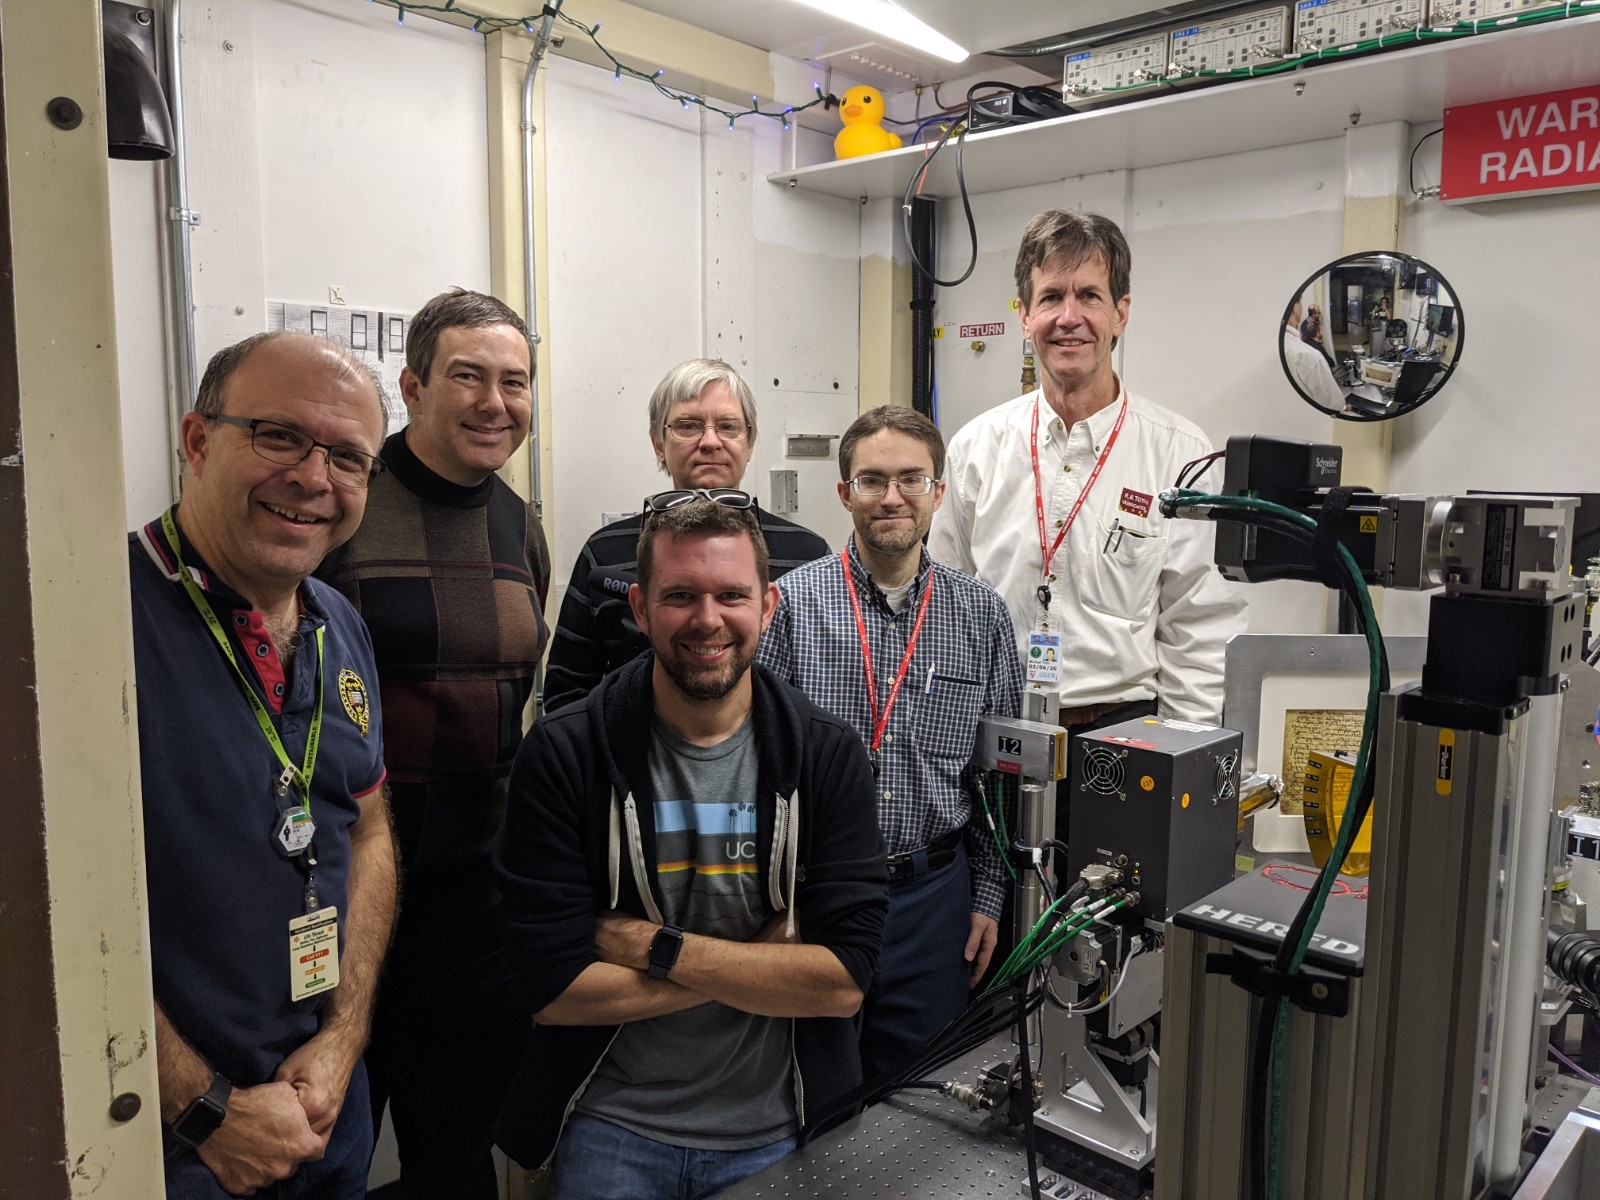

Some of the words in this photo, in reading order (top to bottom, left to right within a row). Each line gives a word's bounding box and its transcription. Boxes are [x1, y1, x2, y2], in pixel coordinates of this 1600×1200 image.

[961, 324, 1003, 337] RETURN
[306, 727, 317, 769] SUSTAINABLE
[1001, 737, 1020, 755] I2
[1441, 751, 1449, 779] Parker
[725, 841, 756, 859] UC
